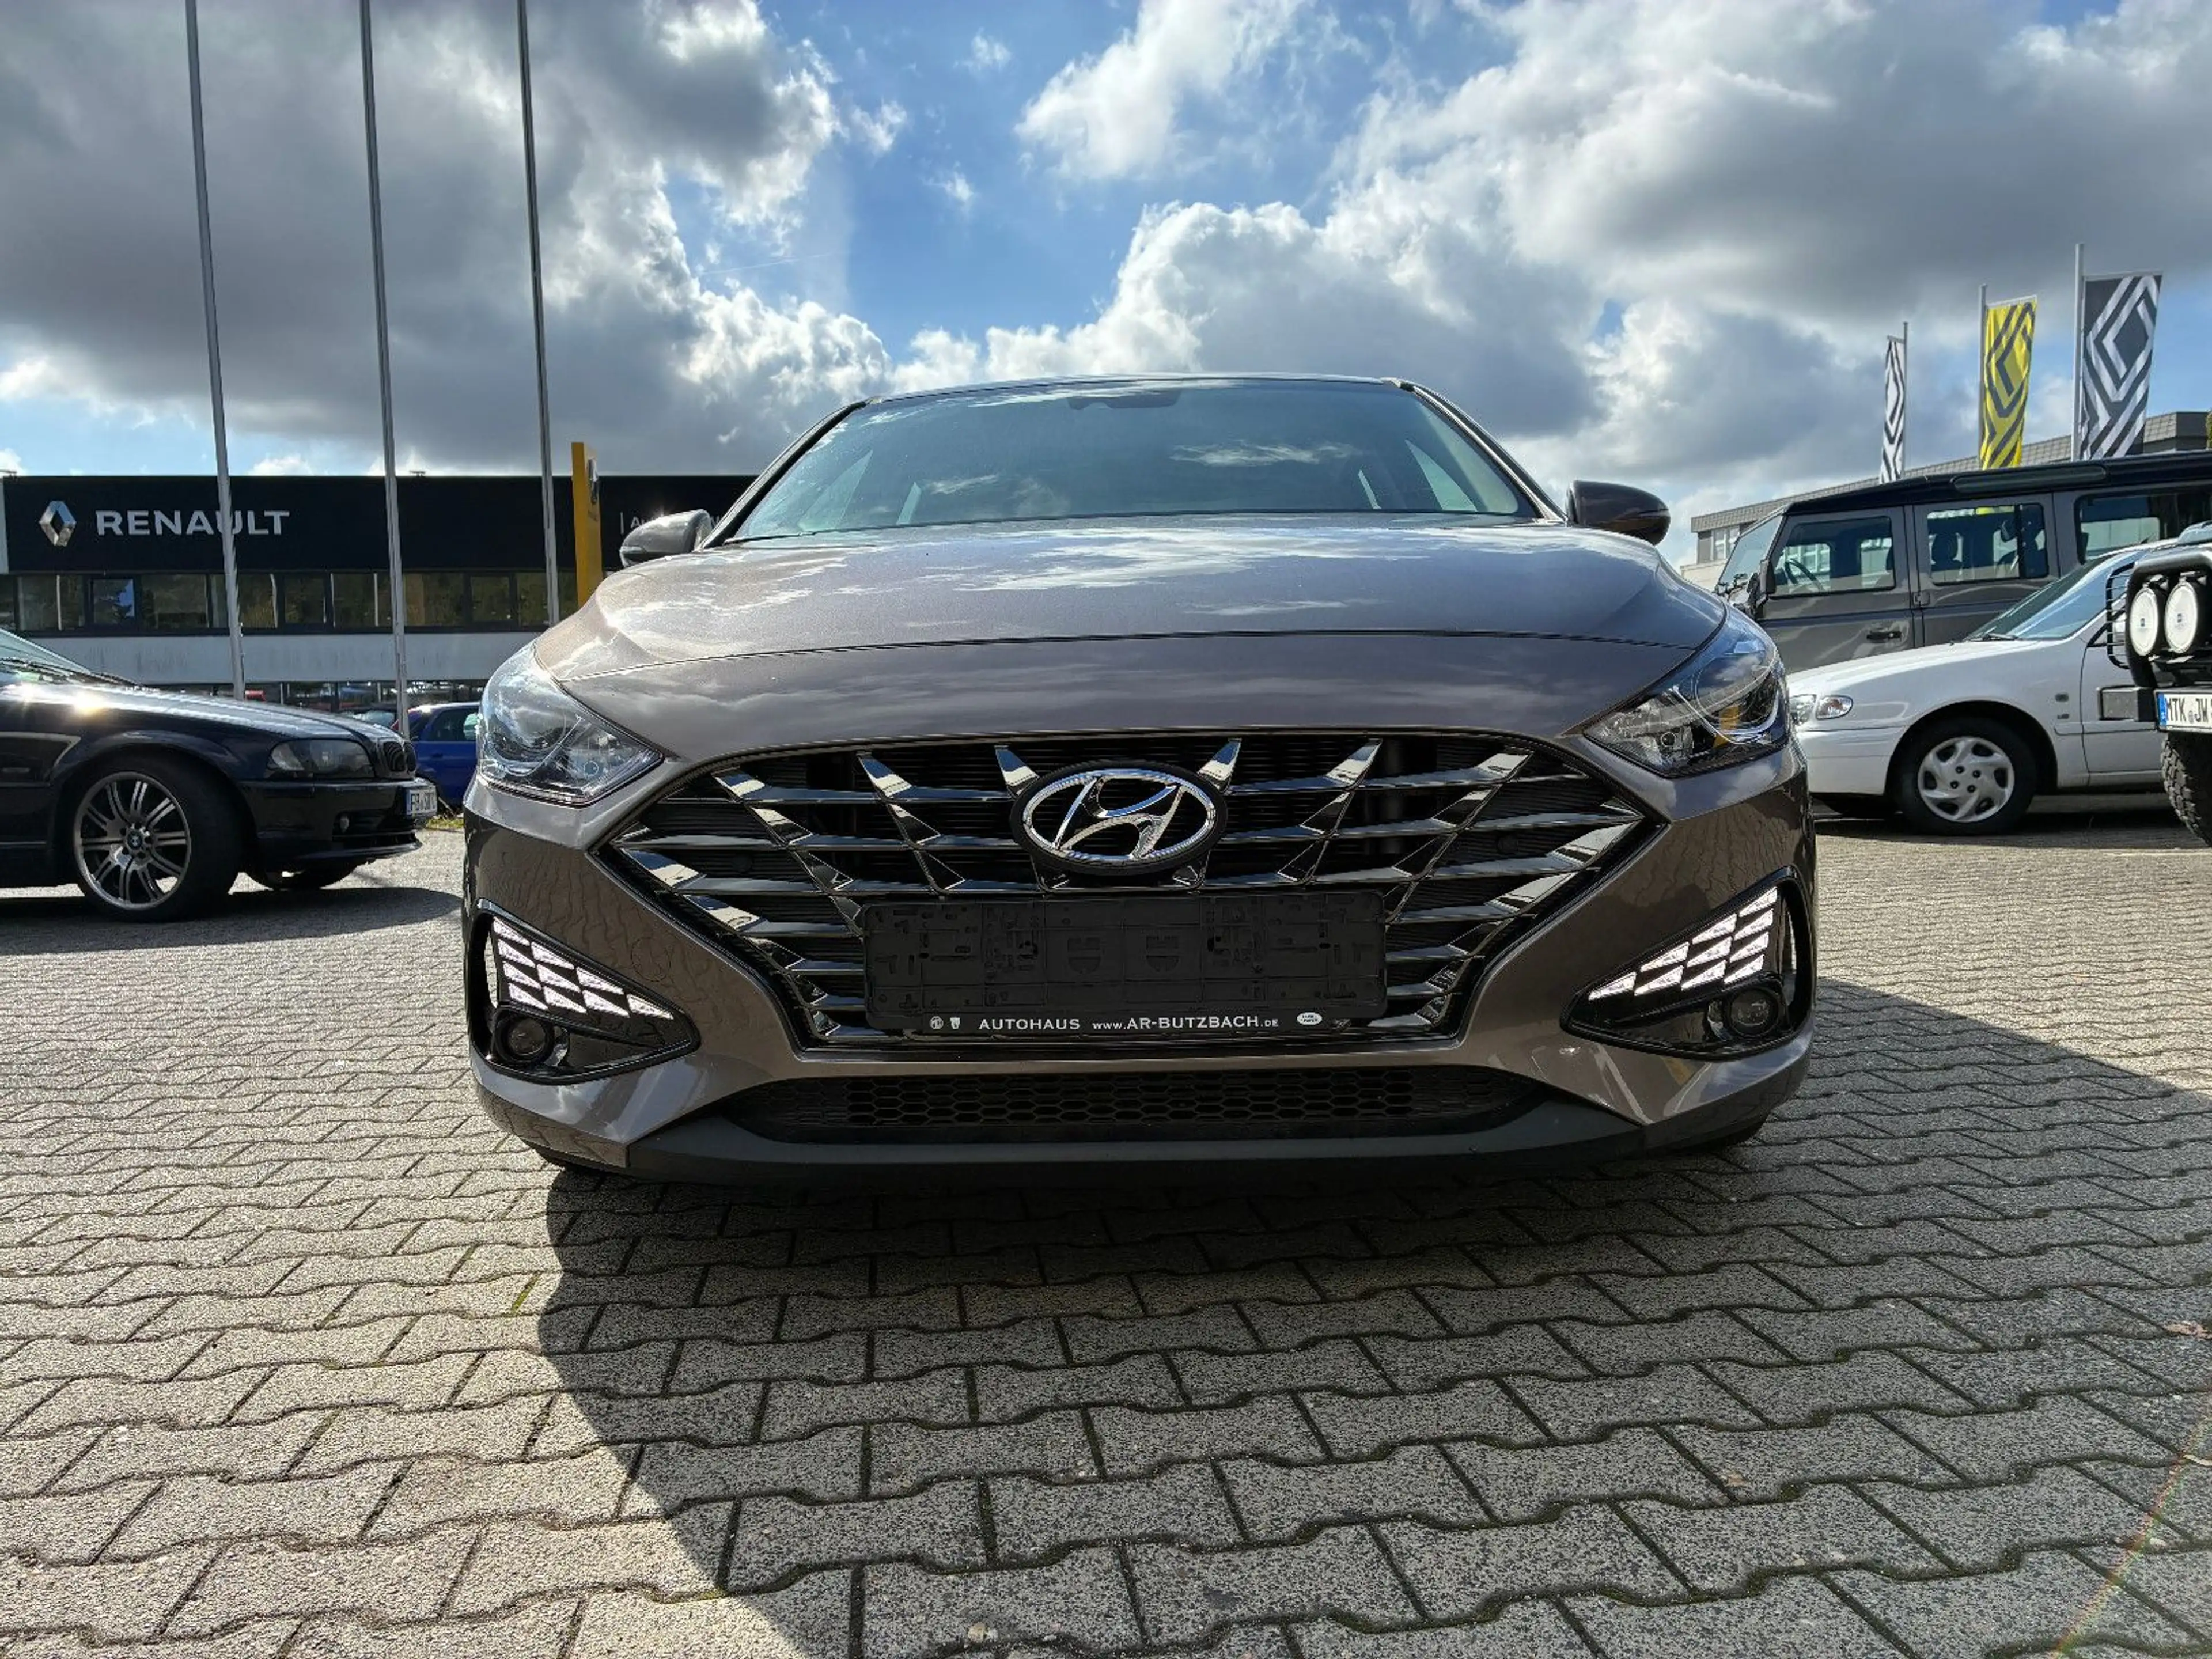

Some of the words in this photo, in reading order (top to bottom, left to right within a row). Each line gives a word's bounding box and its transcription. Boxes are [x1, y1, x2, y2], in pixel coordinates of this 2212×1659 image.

[95, 510, 290, 535] RENAULT
[2165, 698, 2187, 722] MTK
[979, 1018, 1080, 1029] AUTOHAUS
